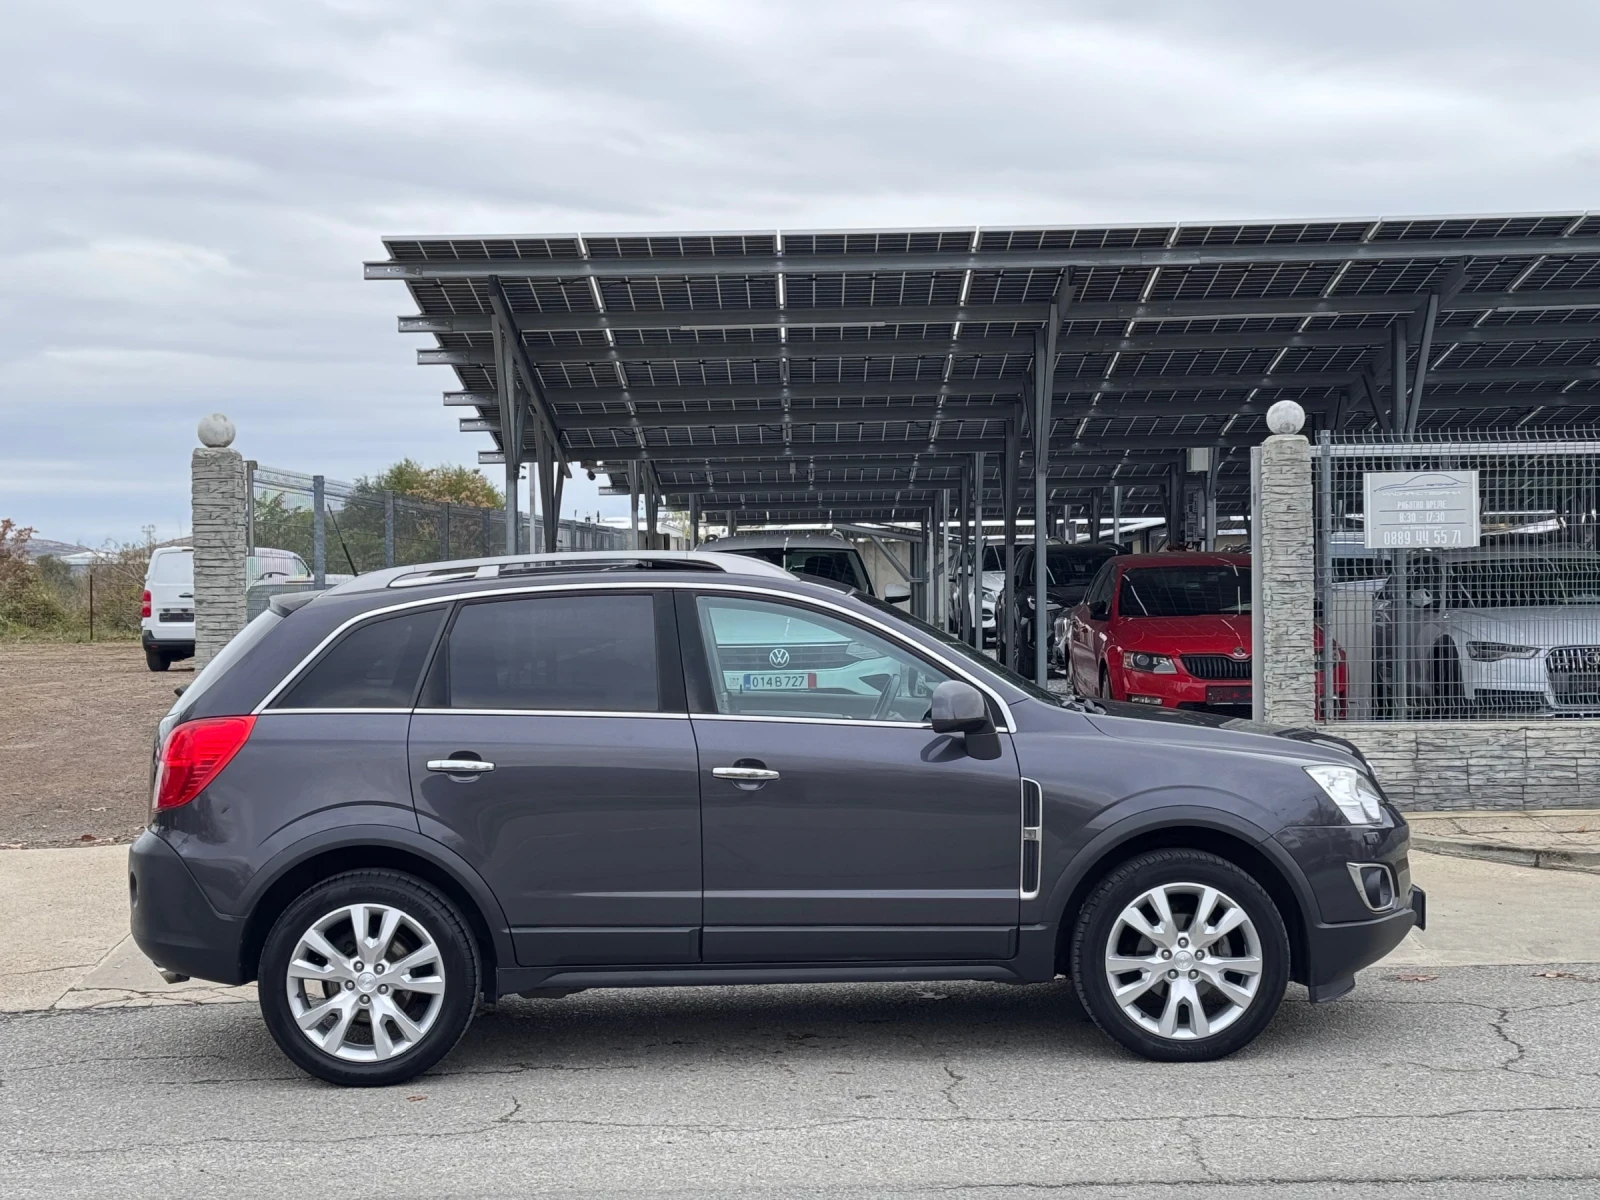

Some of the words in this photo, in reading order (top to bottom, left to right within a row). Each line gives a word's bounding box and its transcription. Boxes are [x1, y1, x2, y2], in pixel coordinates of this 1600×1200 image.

[1399, 512, 1416, 523] 8:30
[1426, 511, 1445, 522] 17:30
[1384, 531, 1411, 545] 0889
[1415, 530, 1429, 545] 44
[1434, 529, 1447, 544] 55
[1452, 529, 1461, 544] 71
